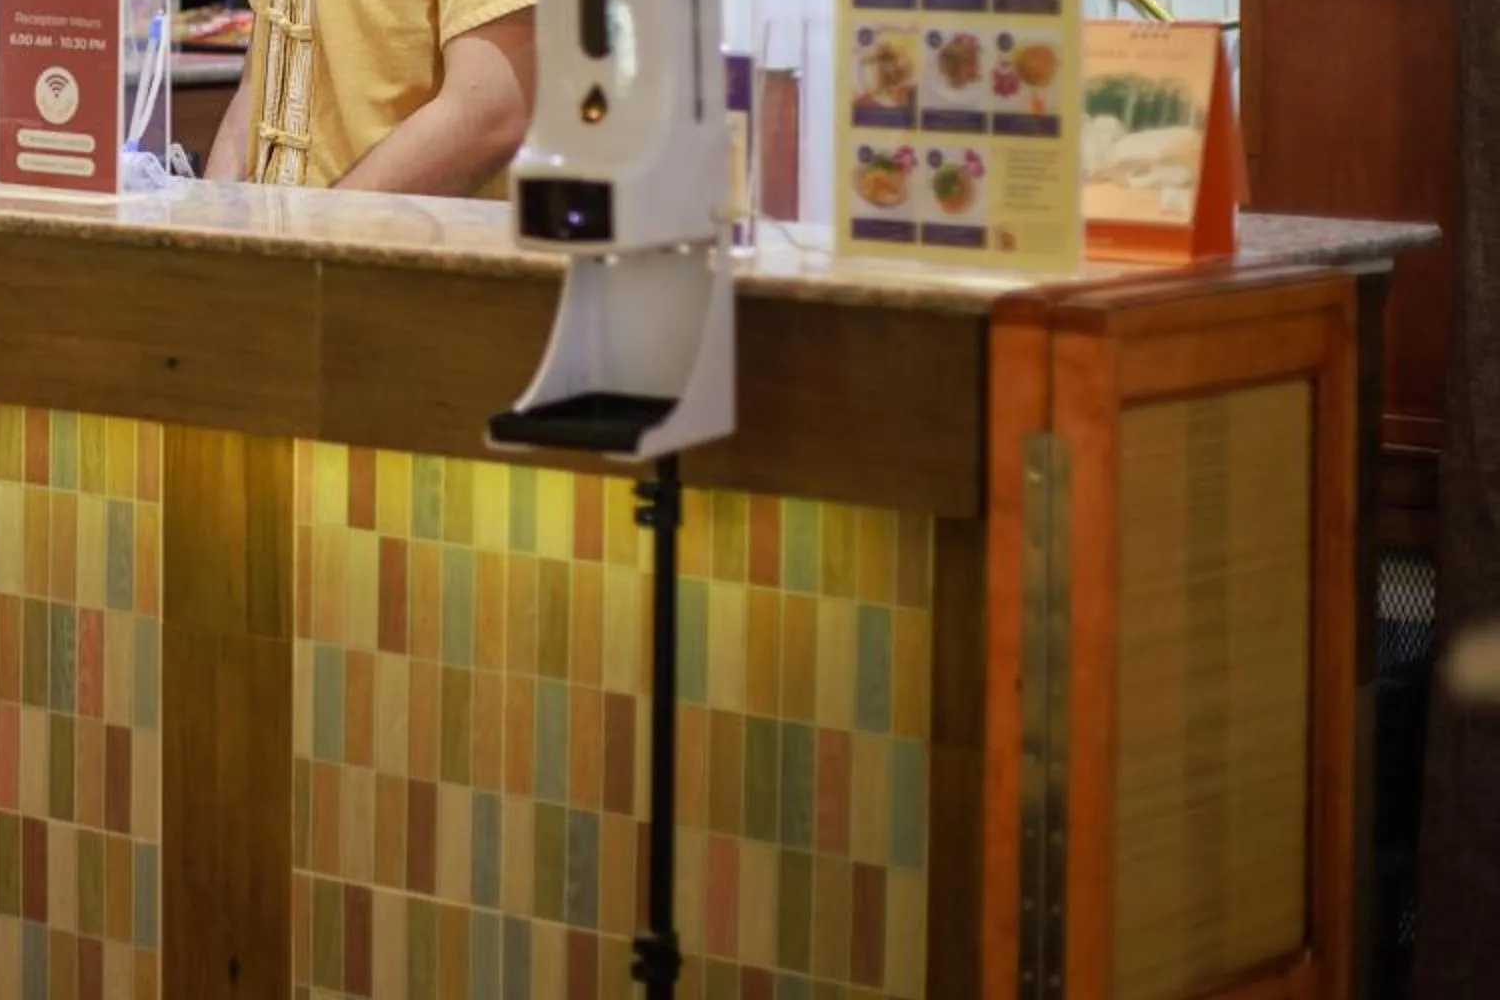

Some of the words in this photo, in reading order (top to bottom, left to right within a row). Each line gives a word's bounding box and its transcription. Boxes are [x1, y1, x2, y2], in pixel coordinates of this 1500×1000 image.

[14, 11, 68, 28] Reception
[69, 15, 102, 29] Hours
[34, 34, 53, 46] AM
[88, 38, 106, 51] PM
